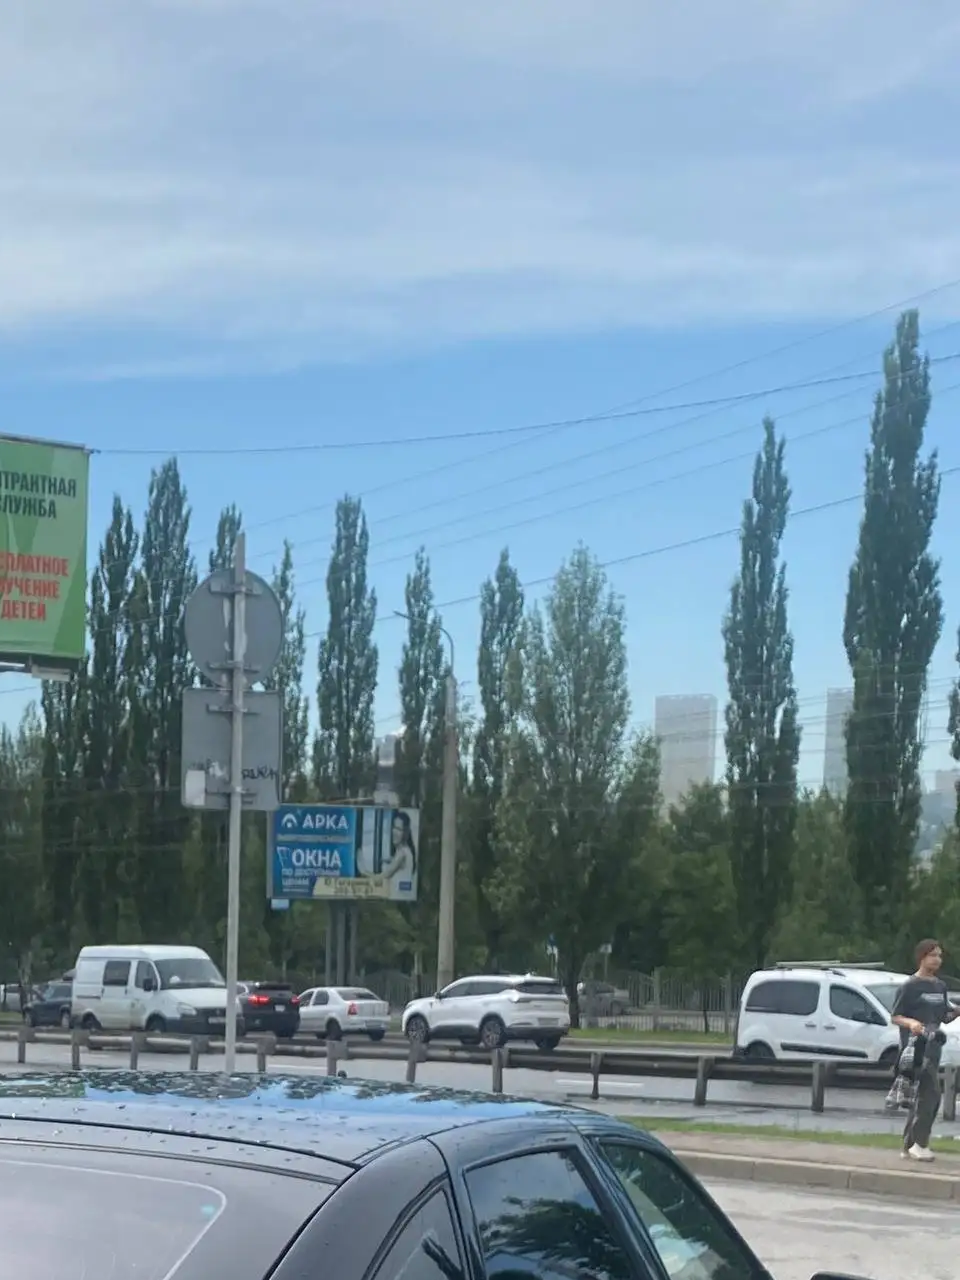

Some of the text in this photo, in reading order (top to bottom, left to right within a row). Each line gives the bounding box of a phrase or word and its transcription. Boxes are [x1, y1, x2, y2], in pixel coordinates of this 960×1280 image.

[1, 599, 46, 622] ДЕТЕЙ
[302, 813, 349, 830] АРКА
[291, 848, 342, 868] ОКНА
